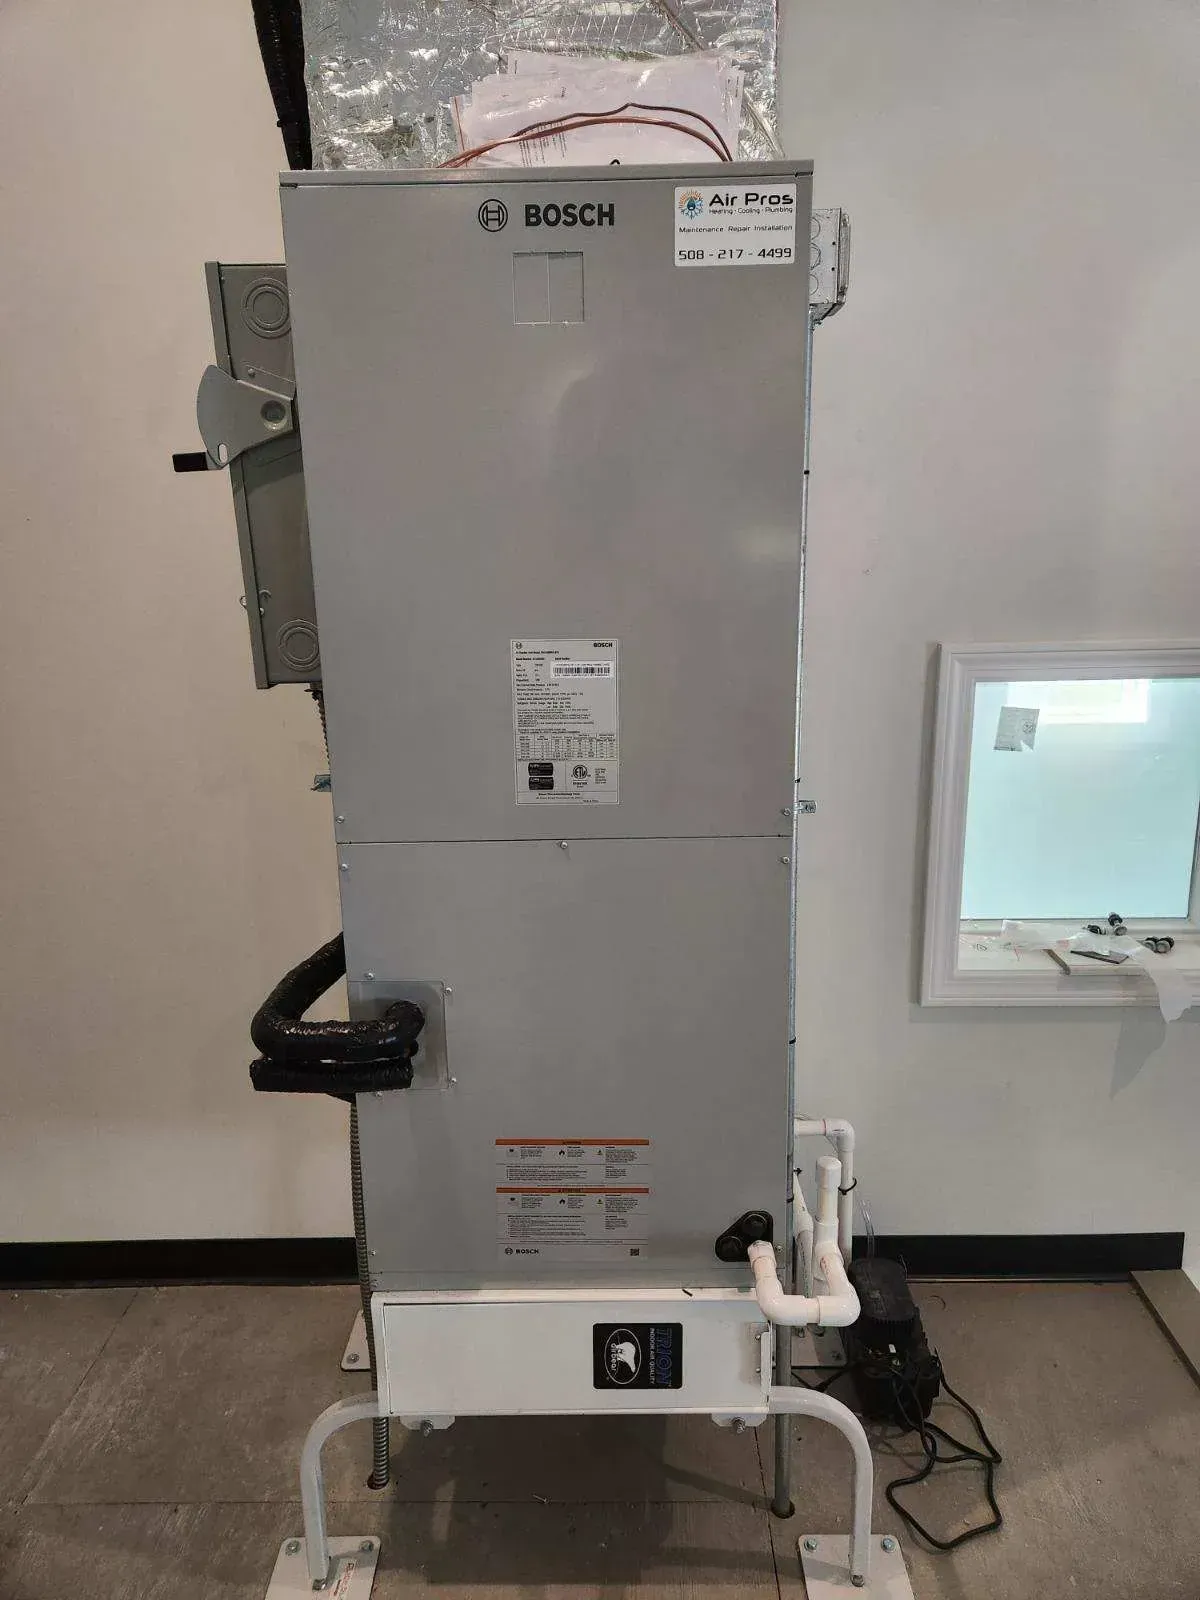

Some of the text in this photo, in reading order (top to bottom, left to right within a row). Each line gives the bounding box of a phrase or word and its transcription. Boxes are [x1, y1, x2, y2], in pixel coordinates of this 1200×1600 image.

[709, 192, 794, 207] Air Pros
[524, 202, 615, 227] BOSCH
[737, 207, 760, 215] Cooling
[764, 206, 793, 214] Plumbing
[678, 249, 705, 260] 508
[717, 248, 744, 259] 217
[757, 247, 792, 258] 4499
[610, 1342, 618, 1371] airbear
[656, 1327, 673, 1384] TRION
